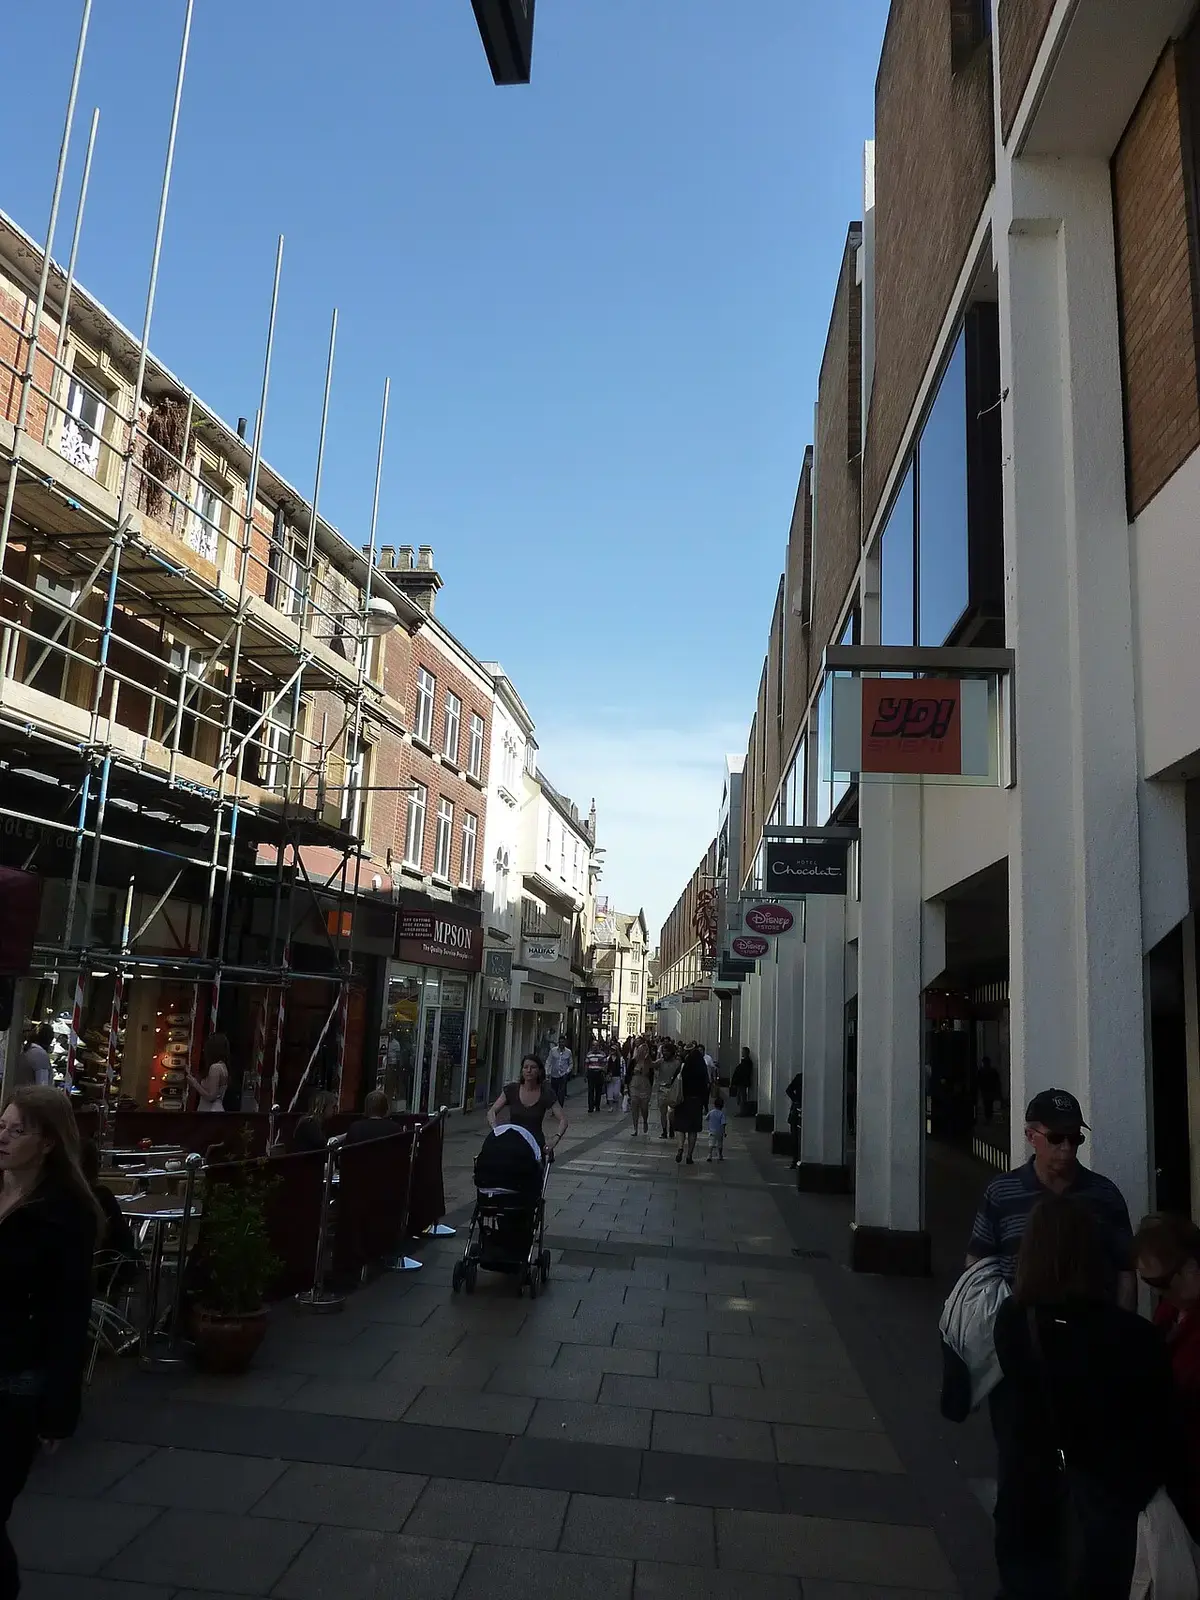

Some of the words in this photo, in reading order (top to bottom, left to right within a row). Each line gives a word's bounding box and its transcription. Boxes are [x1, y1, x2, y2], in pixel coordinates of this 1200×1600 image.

[870, 698, 956, 738] YO!
[433, 920, 473, 949] MPSON
[528, 947, 556, 955] HALIFAX
